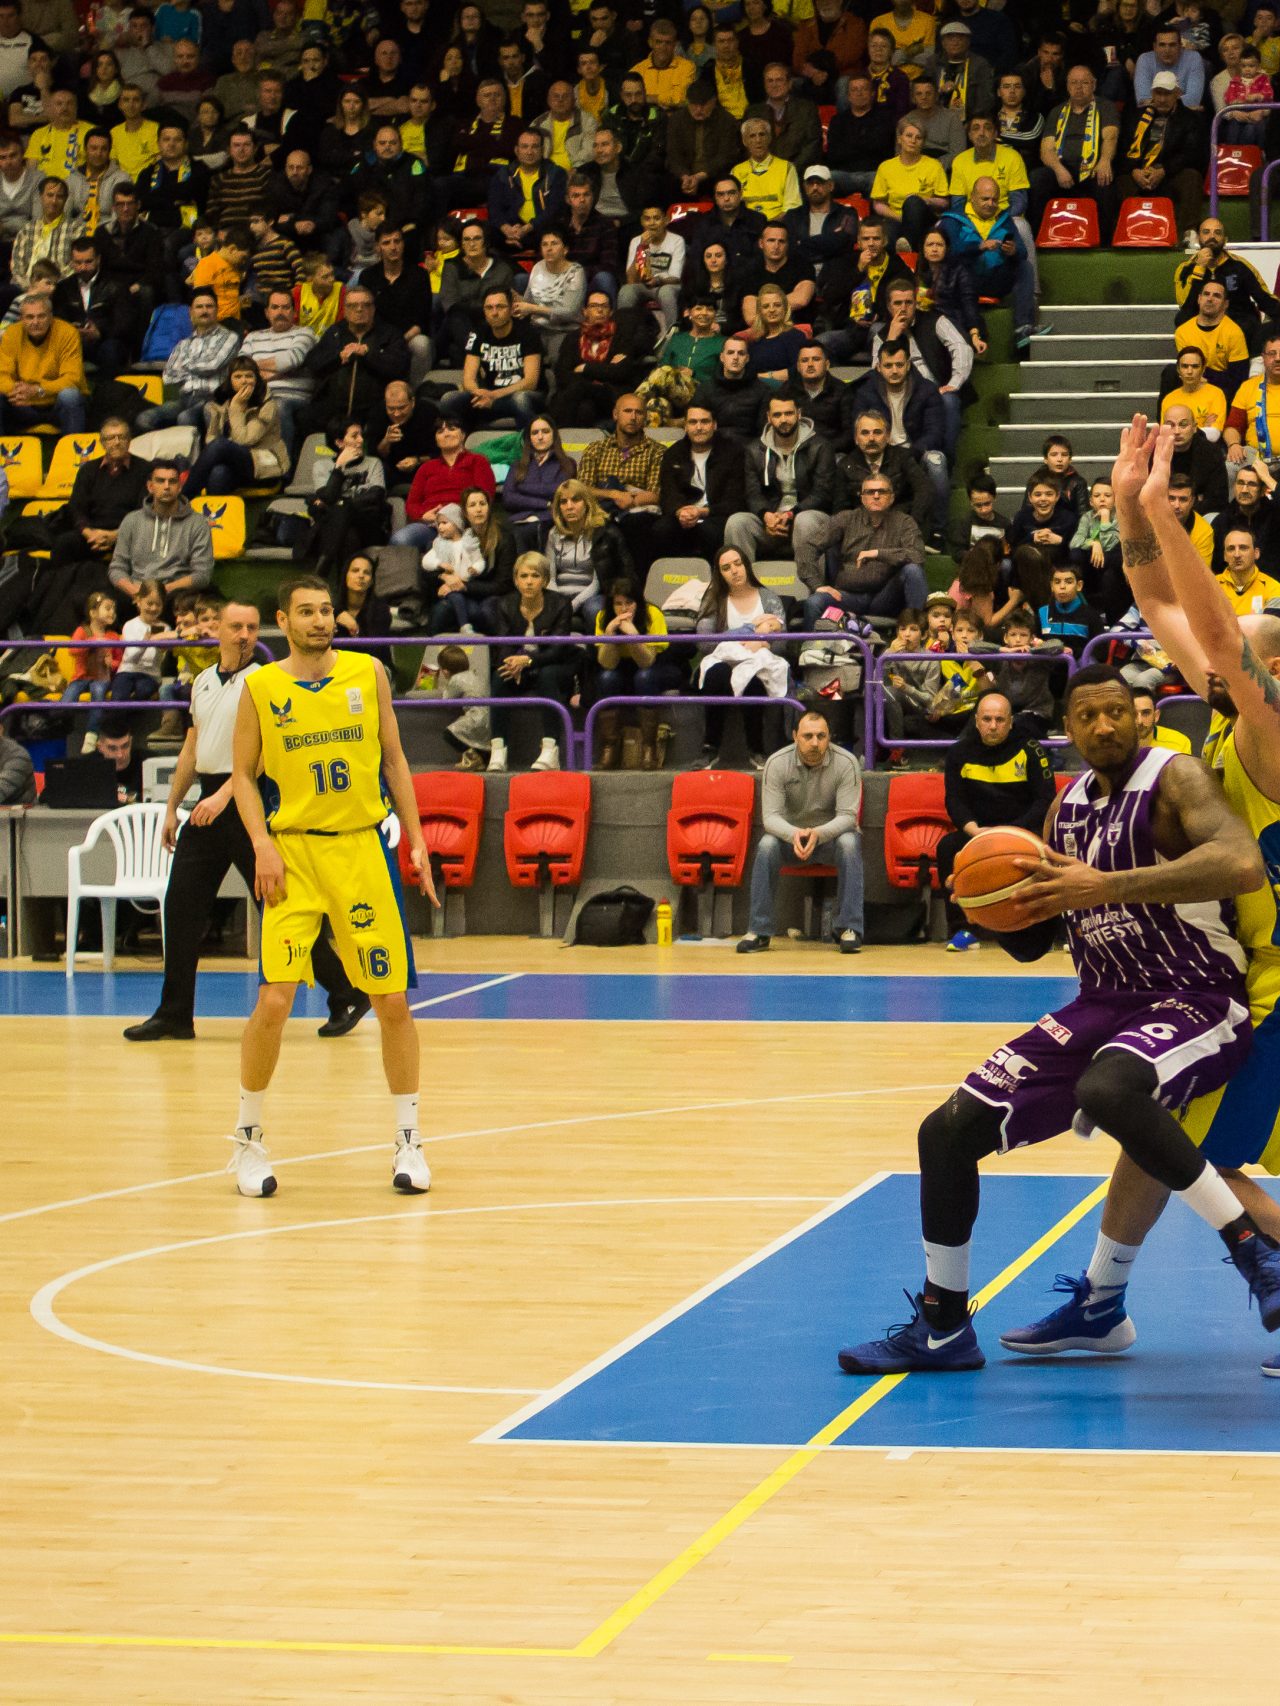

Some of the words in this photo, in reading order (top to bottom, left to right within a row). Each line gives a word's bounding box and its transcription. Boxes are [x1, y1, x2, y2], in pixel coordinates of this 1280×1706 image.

[283, 734, 302, 752] BC
[301, 730, 329, 747] CSU
[329, 723, 363, 742] SIBIU
[309, 758, 351, 795] 16
[1140, 1022, 1178, 1040] 6
